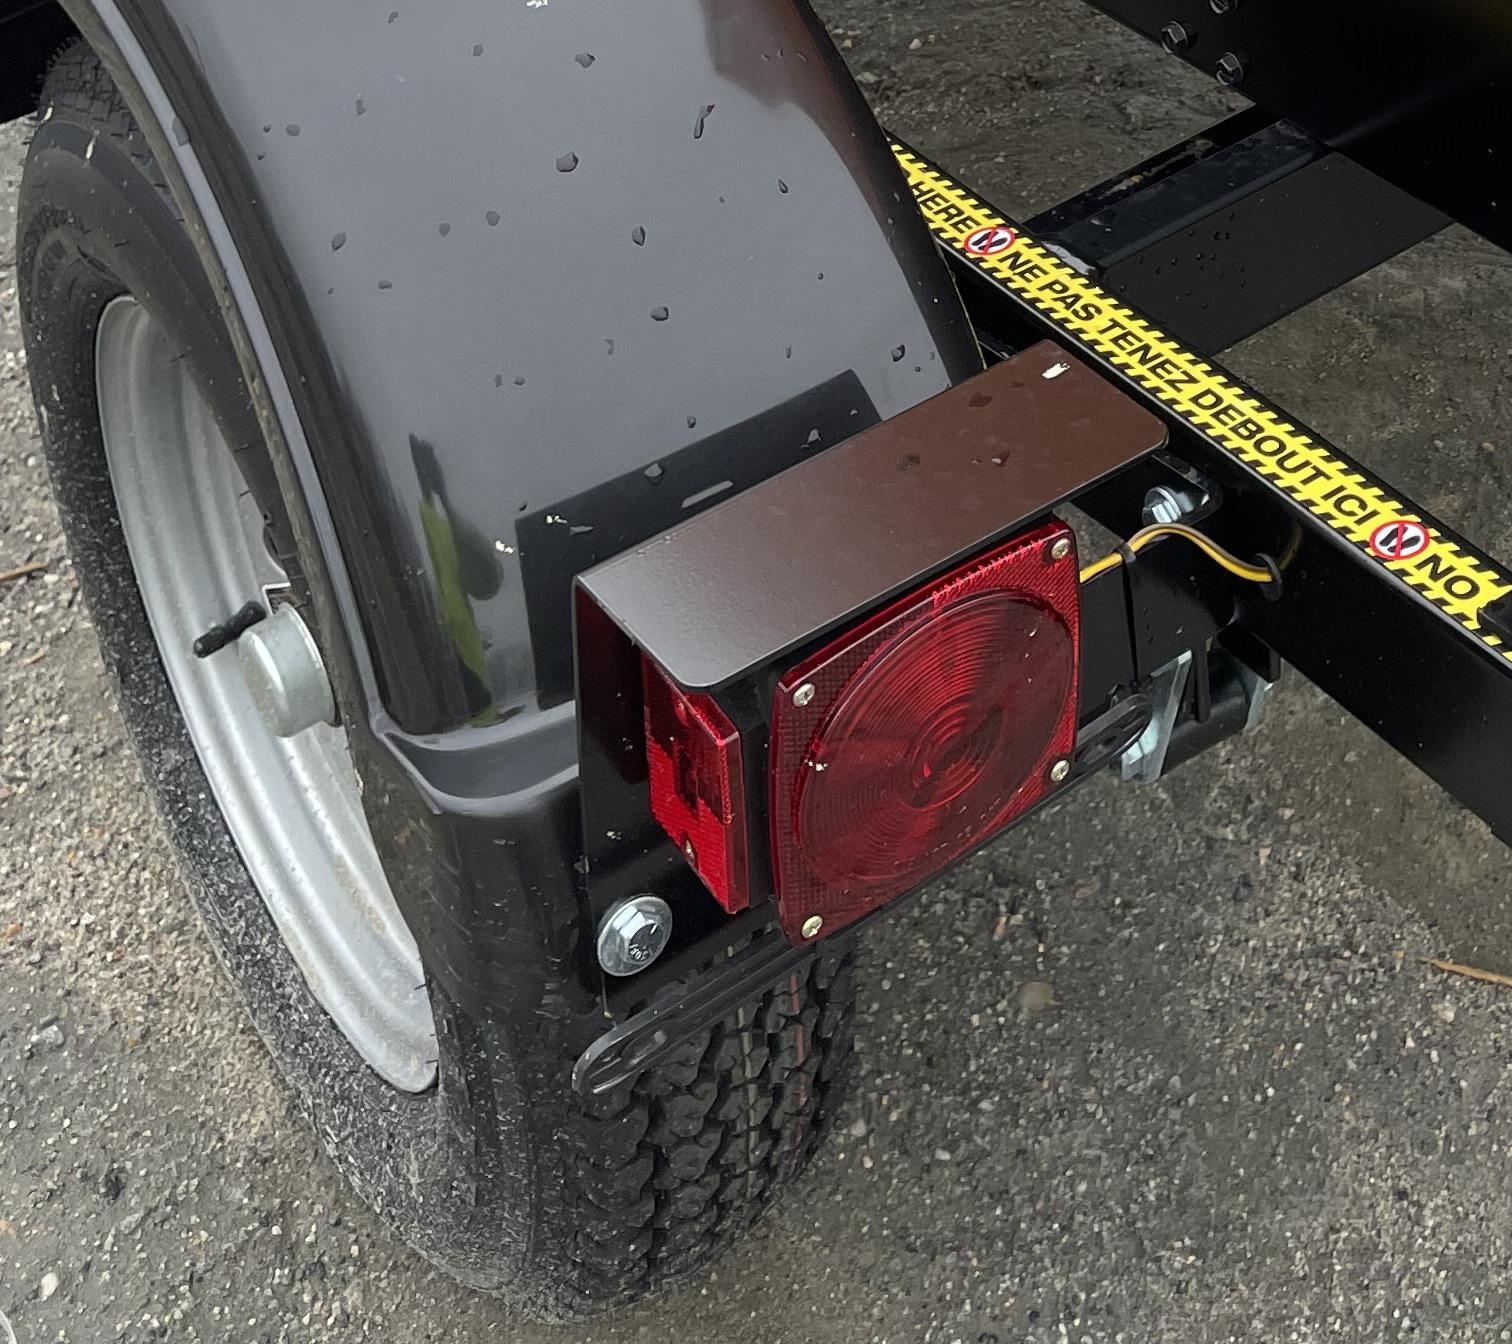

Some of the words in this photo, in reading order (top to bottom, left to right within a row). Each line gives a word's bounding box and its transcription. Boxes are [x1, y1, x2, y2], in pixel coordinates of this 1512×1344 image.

[912, 182, 980, 233] HERE
[1000, 250, 1046, 283] NE
[1047, 281, 1102, 322] PAS
[1100, 319, 1200, 393] TENEZ
[1188, 388, 1333, 486] DEBOUT
[1321, 484, 1381, 526] ICI
[1416, 553, 1481, 601] NO
